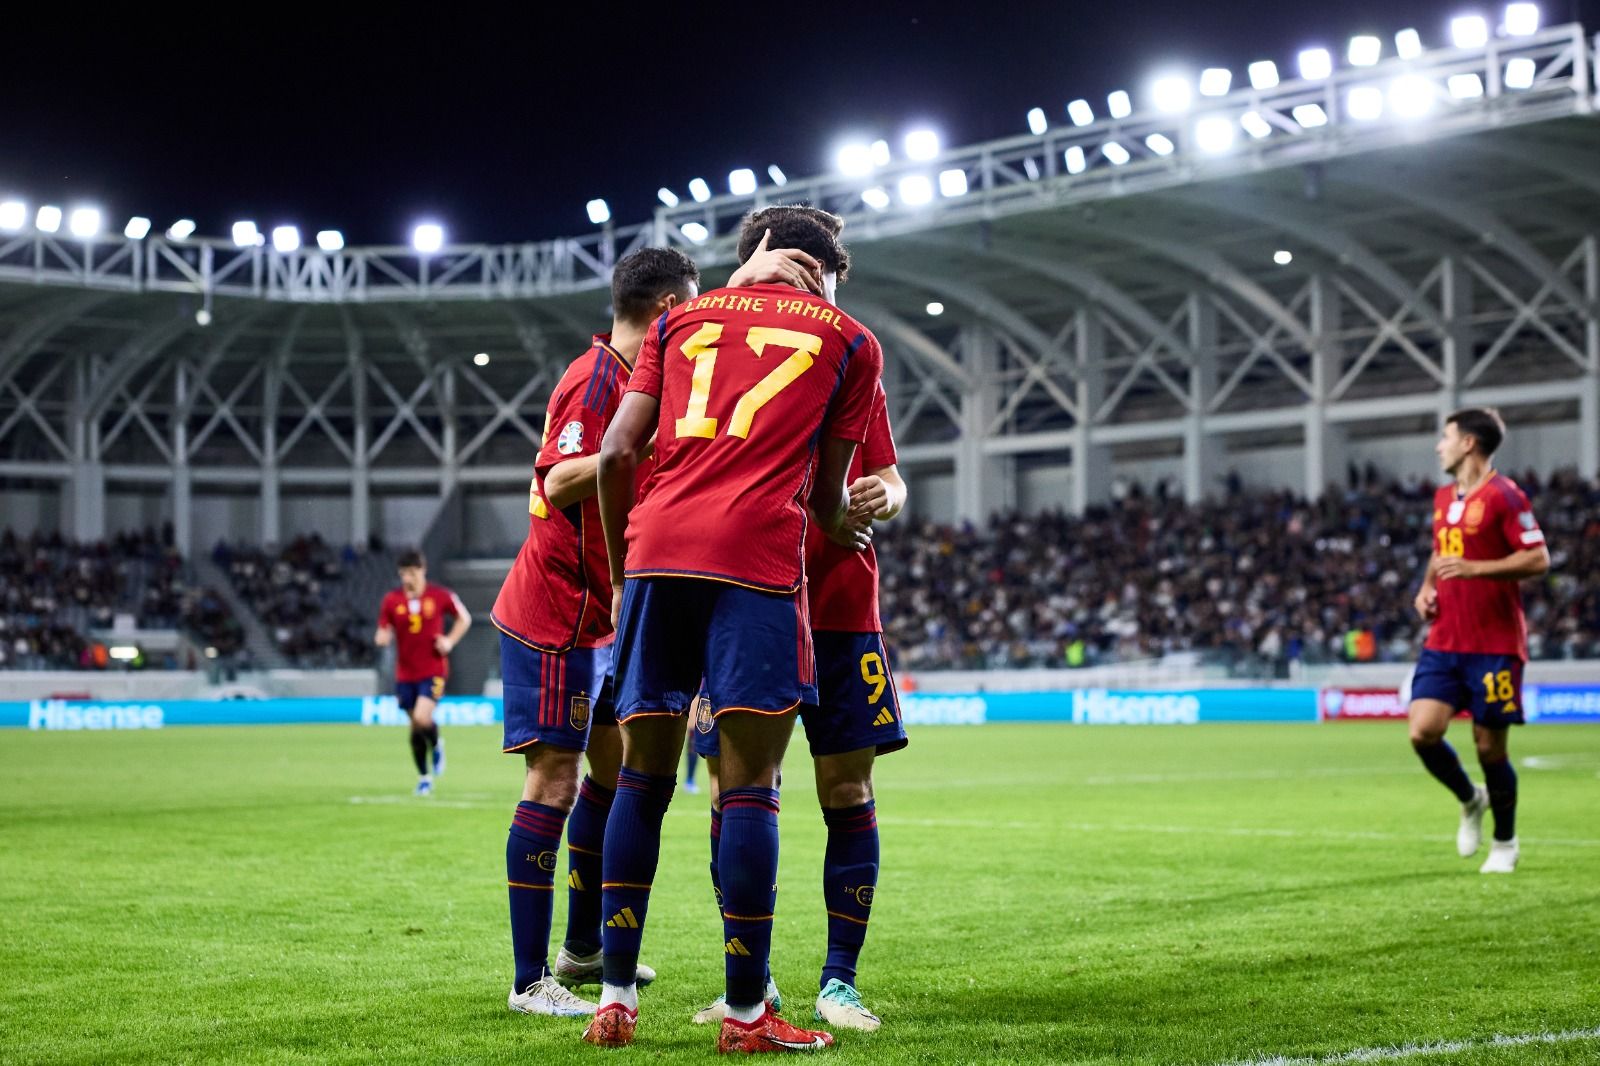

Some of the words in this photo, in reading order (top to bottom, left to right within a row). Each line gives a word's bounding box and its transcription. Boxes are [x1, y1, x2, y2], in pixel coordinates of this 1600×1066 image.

[685, 295, 769, 313] LAMINE
[776, 300, 843, 331] YAMAL
[675, 321, 823, 440] 17
[1437, 526, 1464, 558] 18
[408, 613, 422, 634] 3
[860, 652, 887, 704] 9
[1483, 670, 1515, 704] 18
[29, 700, 164, 729] Hisense
[1072, 689, 1200, 724] Hisense
